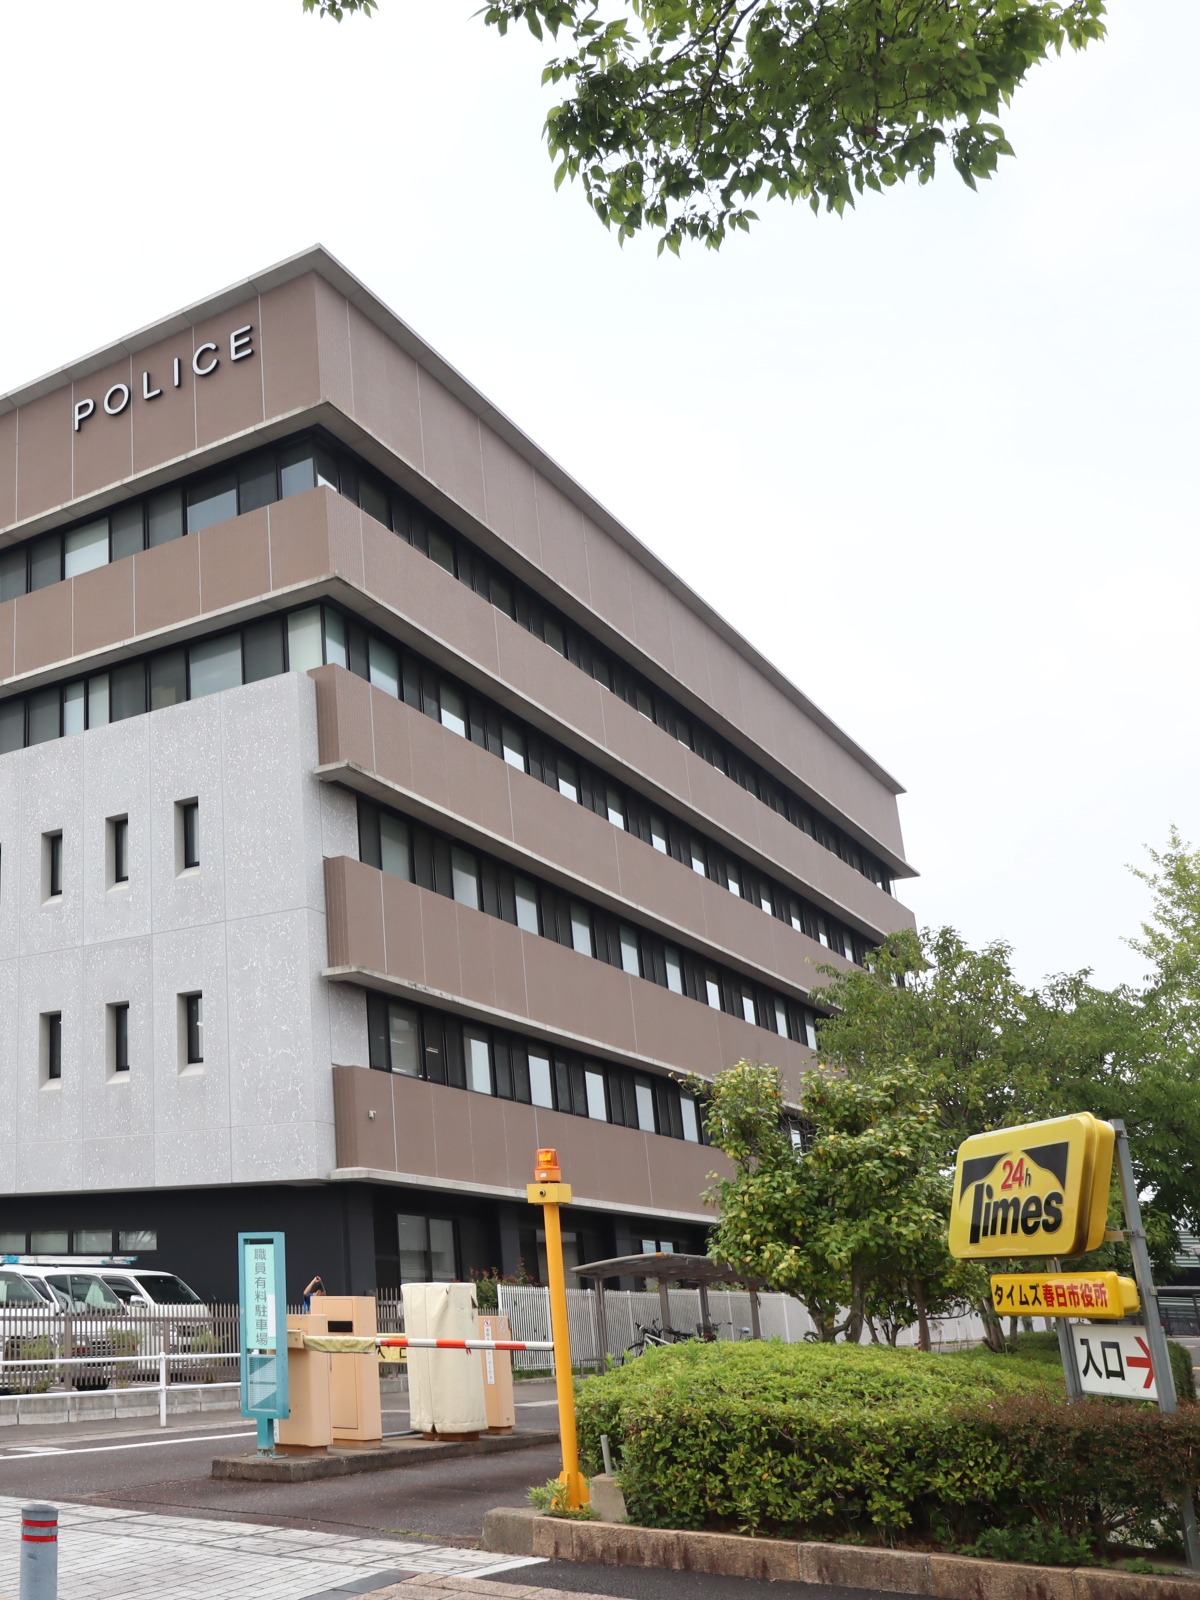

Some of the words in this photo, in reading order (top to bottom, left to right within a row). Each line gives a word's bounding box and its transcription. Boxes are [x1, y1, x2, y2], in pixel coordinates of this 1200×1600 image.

[74, 324, 253, 432] POLICE
[254, 1248, 268, 1346] 職員有料駐車場
[995, 1283, 1108, 1308] タイムズ春日市役所
[1080, 1338, 1126, 1380] 入口
